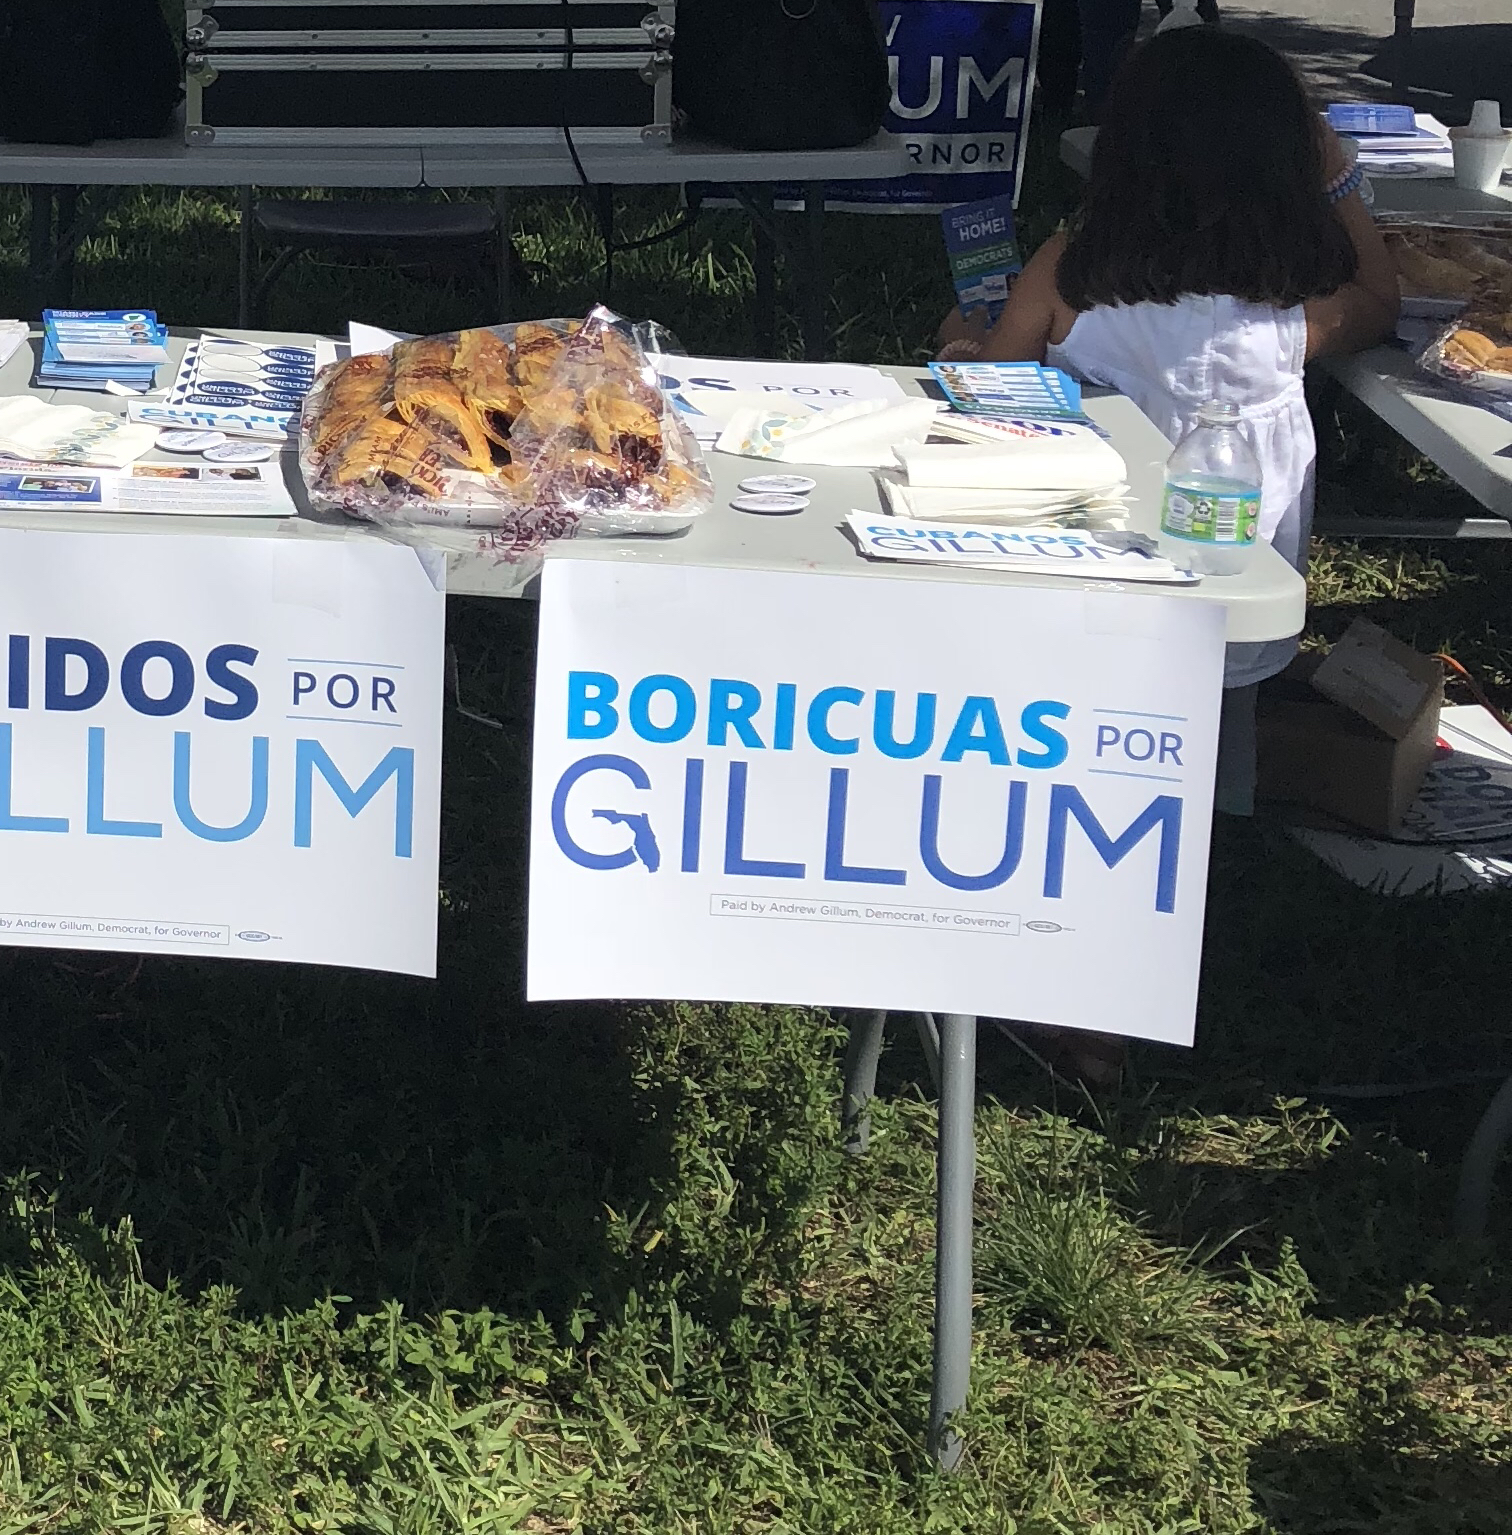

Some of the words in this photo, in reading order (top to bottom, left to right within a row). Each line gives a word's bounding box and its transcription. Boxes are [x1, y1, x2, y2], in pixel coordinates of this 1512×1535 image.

[952, 211, 985, 229] BRING
[959, 217, 1006, 241] HOME!
[956, 247, 1013, 270] DEMOCRATS
[763, 384, 854, 397] POR
[866, 525, 1088, 546] CUBANOS
[870, 536, 1154, 560] GILLUM
[291, 671, 398, 714] POR
[566, 670, 1072, 769] BORICUAS
[1096, 725, 1184, 767] POR
[551, 753, 1184, 914] GILLUM
[721, 899, 747, 911] Paid
[751, 900, 766, 914] by
[769, 902, 816, 915] Andrew
[821, 904, 861, 918] Gillum,
[865, 907, 928, 923] Democrat,
[932, 911, 949, 924] for
[953, 913, 1010, 928] Governor
[0, 918, 13, 930] by
[16, 918, 56, 930] Andrew
[60, 920, 94, 932] Gillum,
[98, 923, 151, 935] Democrat,
[154, 925, 169, 935] for
[172, 926, 221, 939] Governor
